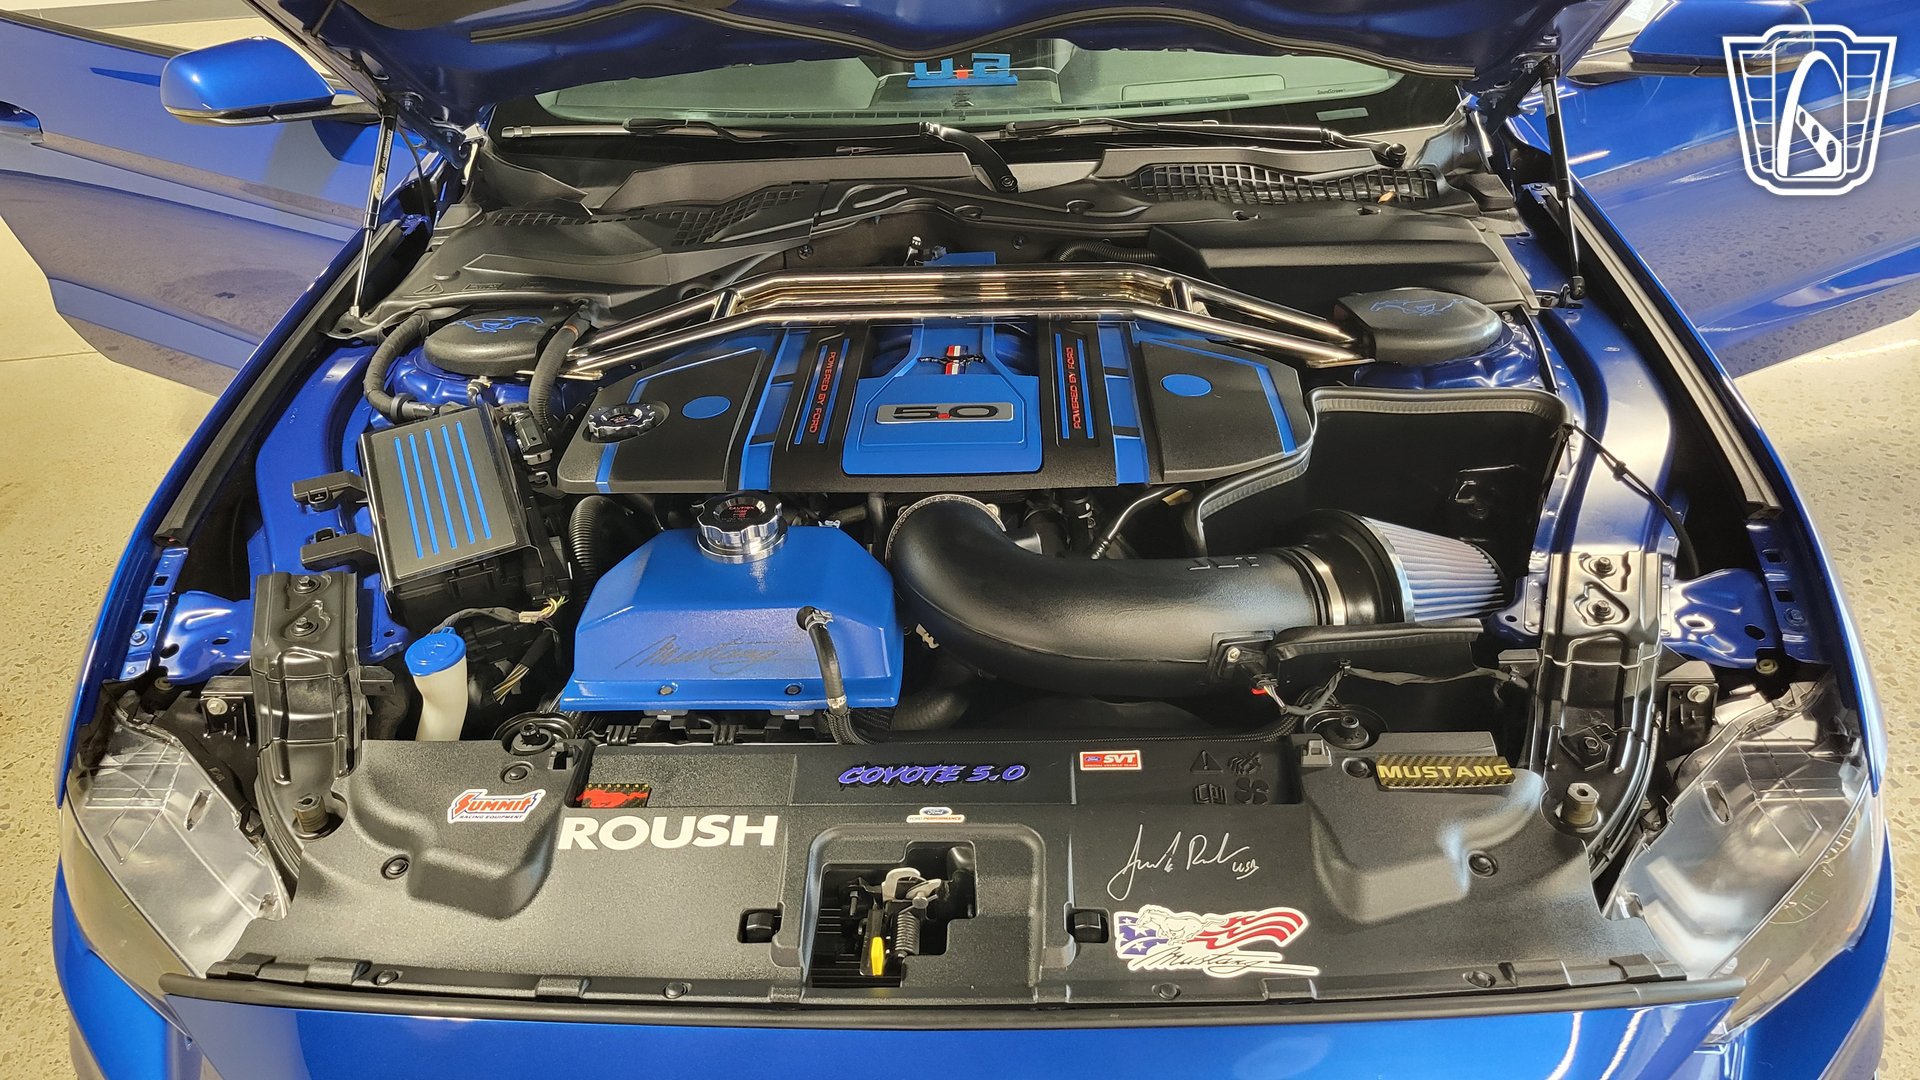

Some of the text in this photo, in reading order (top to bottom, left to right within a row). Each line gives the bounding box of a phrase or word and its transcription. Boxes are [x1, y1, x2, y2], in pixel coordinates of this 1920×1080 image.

[809, 351, 837, 433] POWERED BY FORD
[1065, 347, 1081, 429] POWERED BY FORD
[892, 405, 999, 419] 5.0
[1103, 754, 1136, 763] SVT
[838, 764, 1026, 784] COYOTE 5.0
[1379, 765, 1512, 778] MUSTANG
[557, 815, 779, 850] ROUSH
